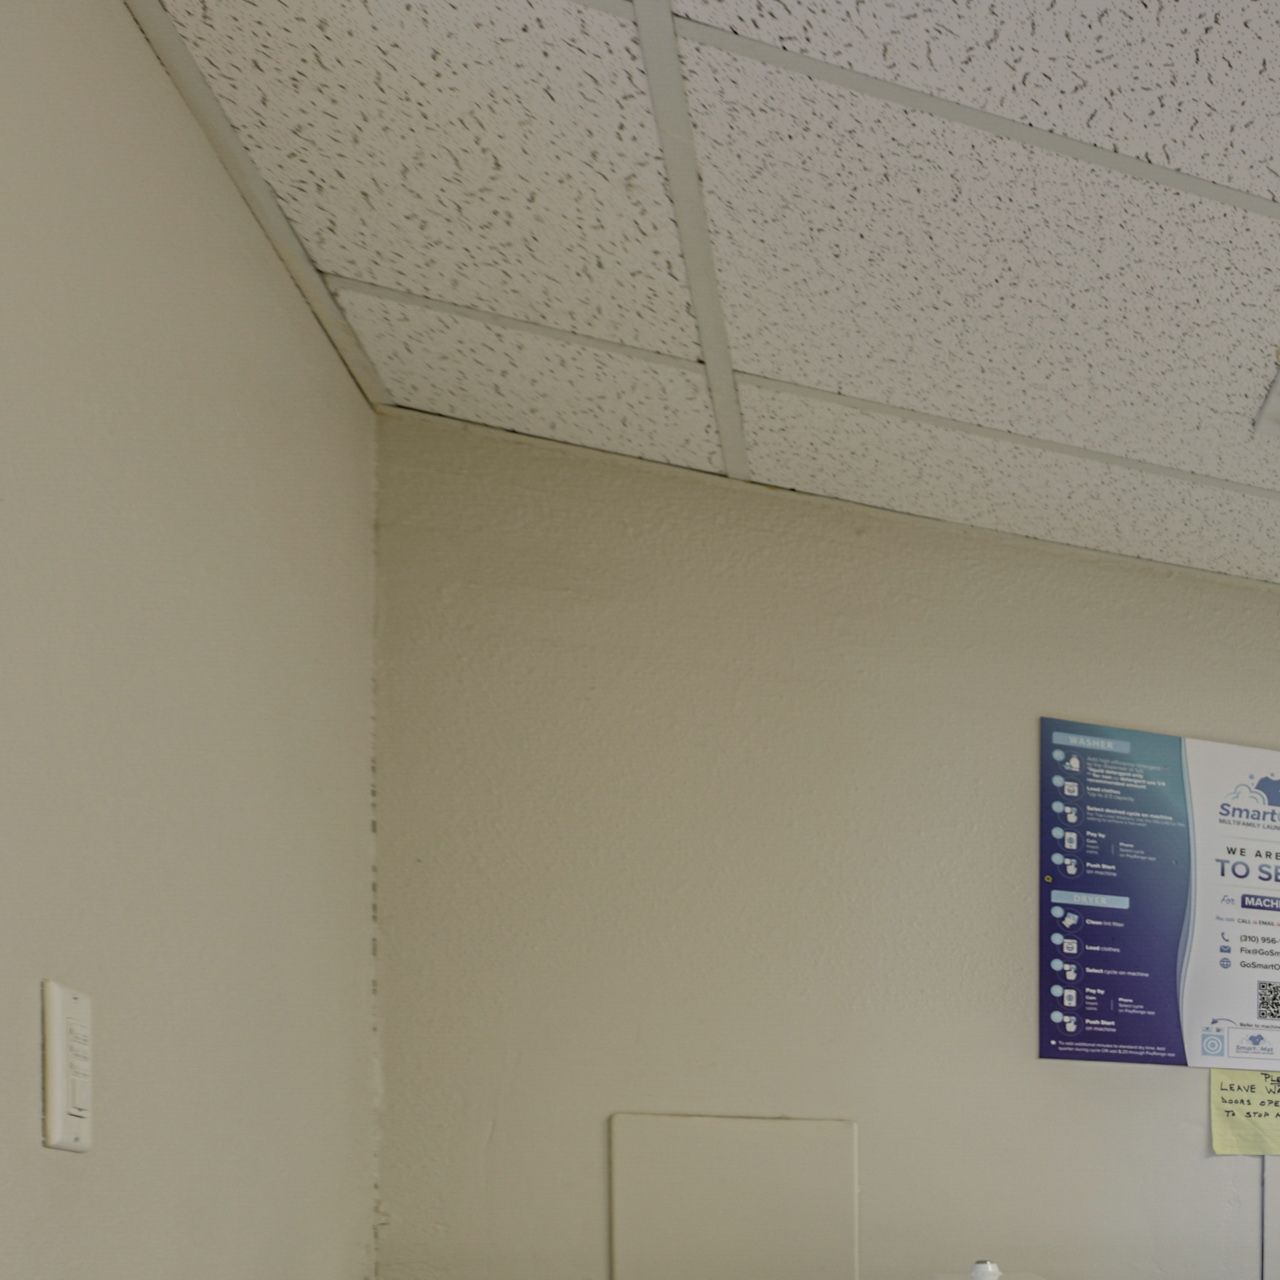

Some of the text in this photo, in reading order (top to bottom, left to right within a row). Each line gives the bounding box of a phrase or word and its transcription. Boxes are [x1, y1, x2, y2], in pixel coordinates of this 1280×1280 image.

[1069, 736, 1114, 750] WASHER
[1218, 818, 1260, 829] MULTIFAMILY
[1226, 846, 1246, 857] WE
[1254, 850, 1280, 860] ARE
[1215, 858, 1250, 879] TO
[1073, 894, 1107, 905] DRYER
[1240, 935, 1259, 944] (310)
[1220, 1082, 1256, 1094] LEAVE
[1245, 1110, 1270, 1119] STOP
